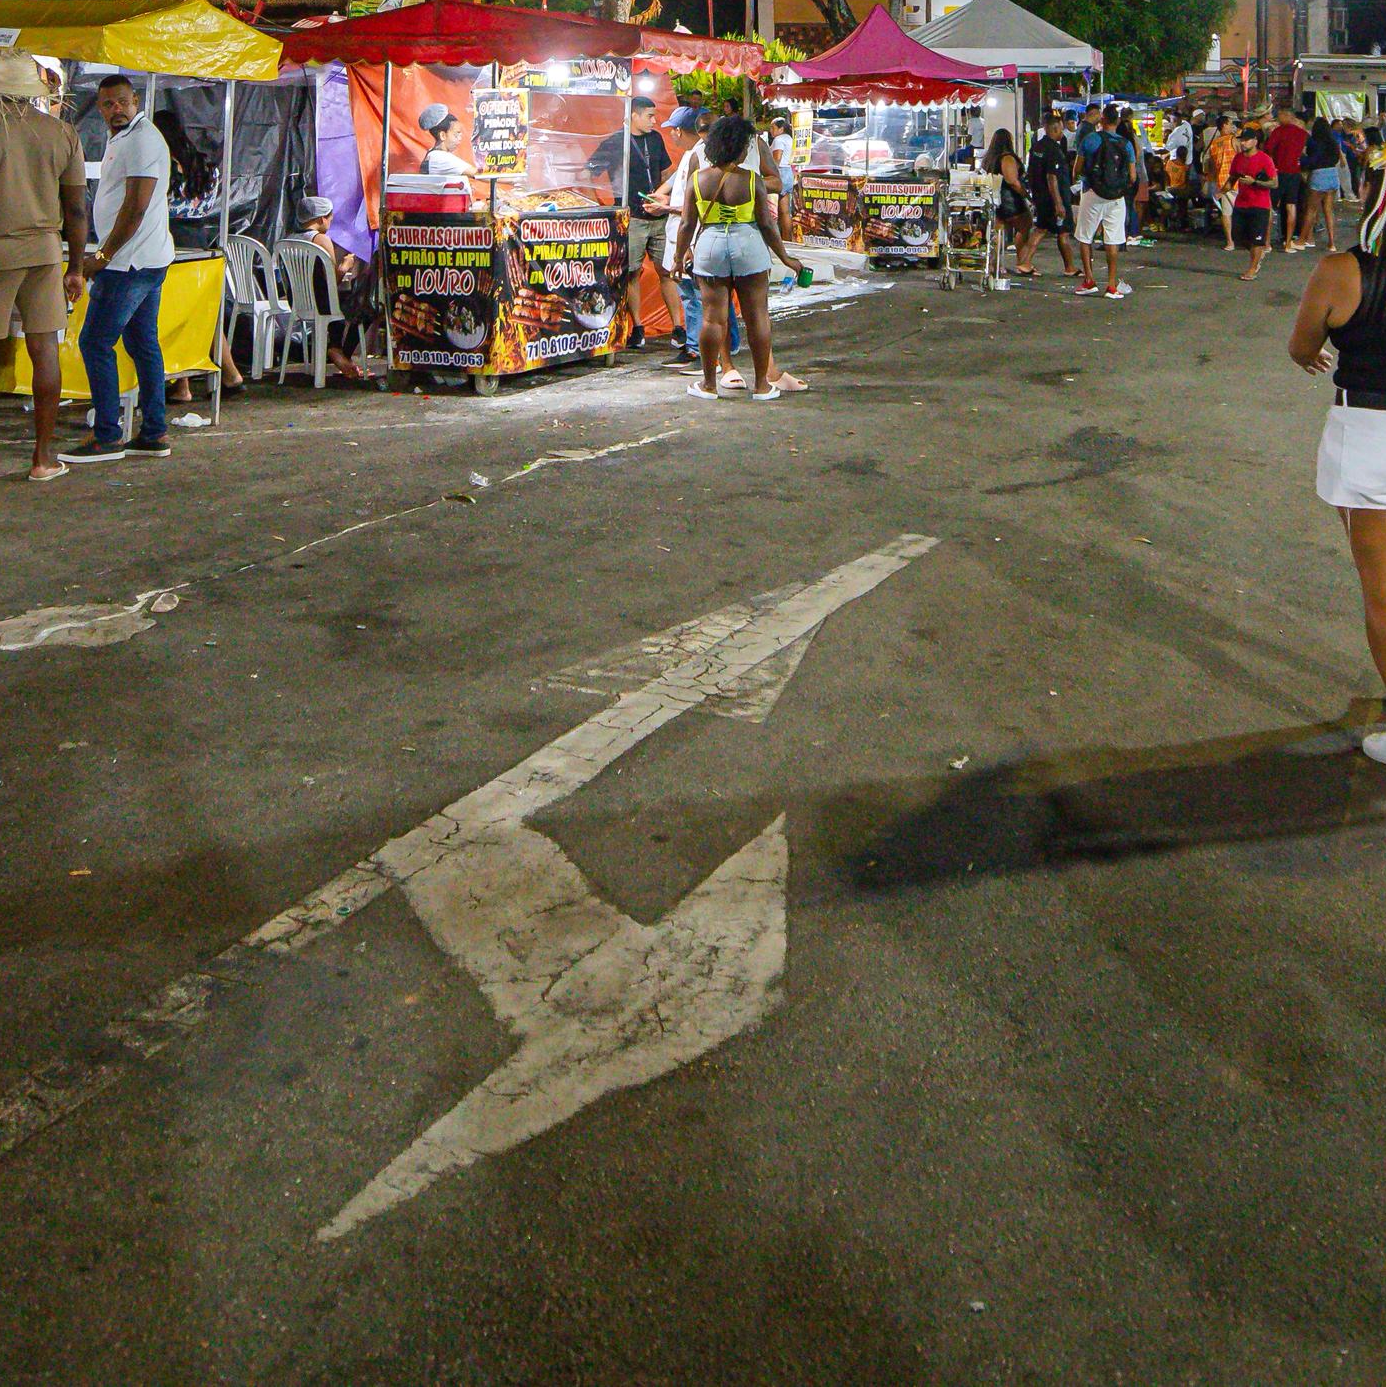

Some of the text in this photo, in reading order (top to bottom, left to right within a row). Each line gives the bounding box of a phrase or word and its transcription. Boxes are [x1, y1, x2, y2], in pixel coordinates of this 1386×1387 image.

[580, 59, 617, 80] LOURO
[479, 100, 521, 116] OFERTA
[505, 117, 517, 129] DE
[478, 141, 503, 152] CARNE
[502, 140, 513, 151] DO
[513, 139, 527, 151] SOL
[485, 154, 516, 166] do Louro
[863, 182, 936, 196] CHURRASQUINHO
[813, 199, 841, 215] LOURO
[871, 195, 897, 205] PIRÃO
[897, 196, 909, 205] DE
[909, 196, 934, 205] AIPIM
[869, 204, 923, 220] DO LOURO
[521, 217, 611, 242] CHURRASQUINHO
[387, 226, 494, 251] CHURRASQUINHO
[390, 248, 491, 268] & PIRÃO DE AIPIM
[524, 241, 610, 261] & PIRÃO DE AIPIM
[397, 267, 475, 297] DO LOURO
[529, 260, 596, 292] DO LOURO
[527, 328, 610, 360] 71 9.8108-0963
[399, 351, 484, 368] 71 9.8108-0963
